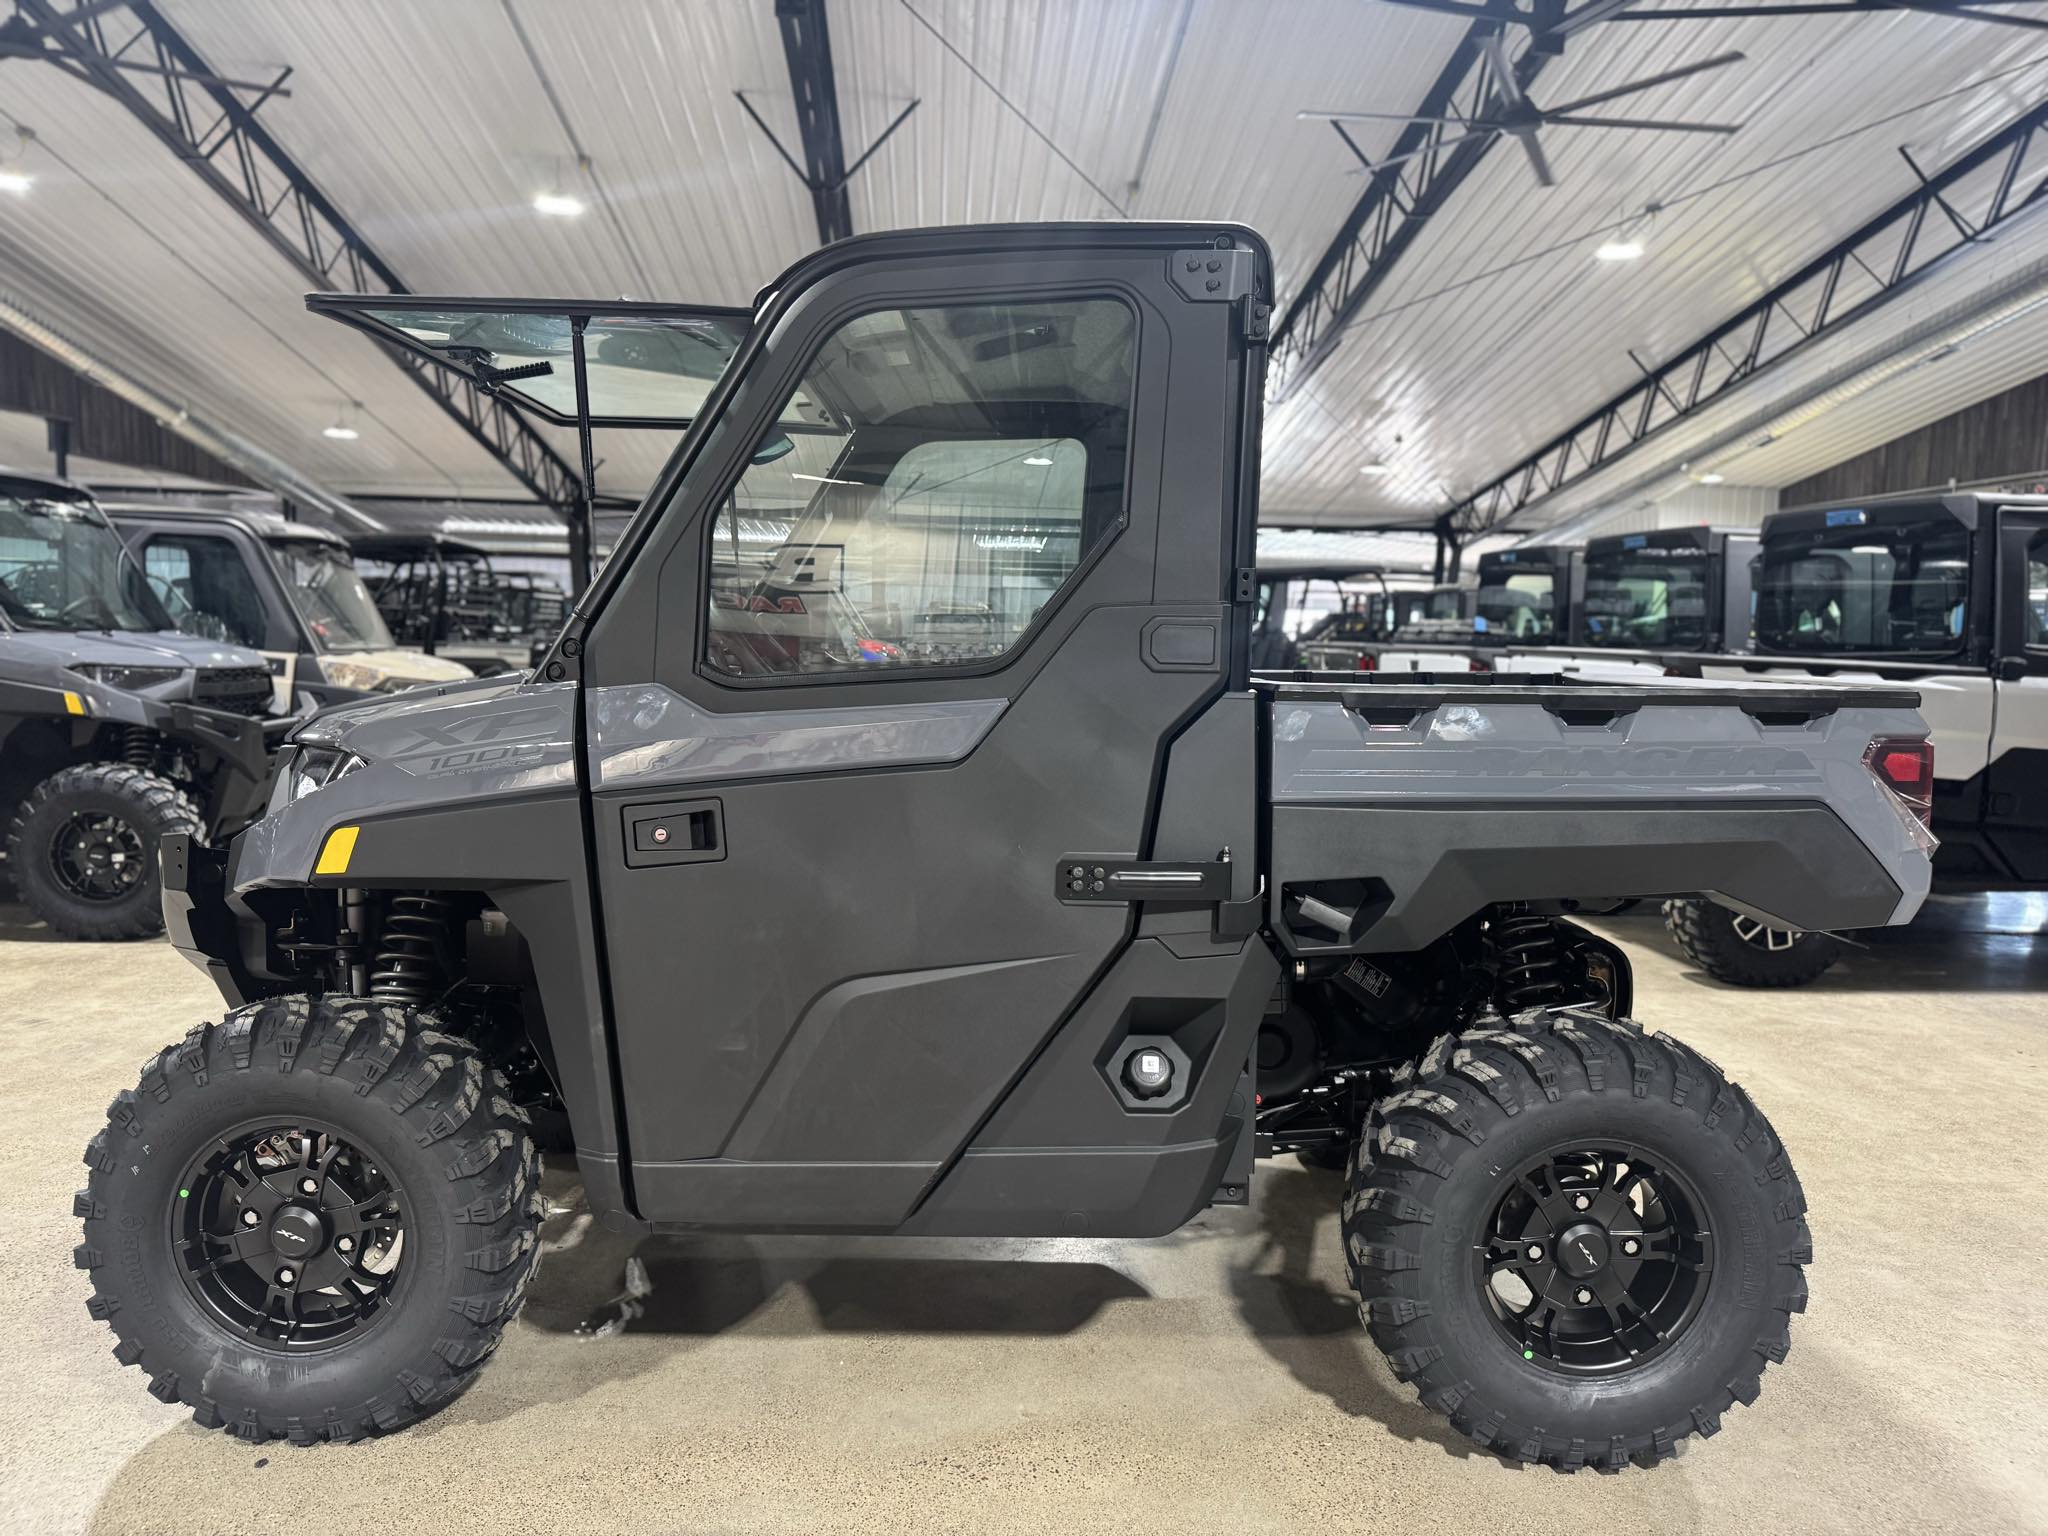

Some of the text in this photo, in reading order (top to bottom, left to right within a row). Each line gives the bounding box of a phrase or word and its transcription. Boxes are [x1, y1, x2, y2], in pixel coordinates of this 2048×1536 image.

[393, 710, 558, 755] XP
[429, 744, 544, 771] 1000
[1462, 746, 1783, 777] RANGER
[275, 1228, 306, 1243] XP
[1578, 1241, 1599, 1266] XP
